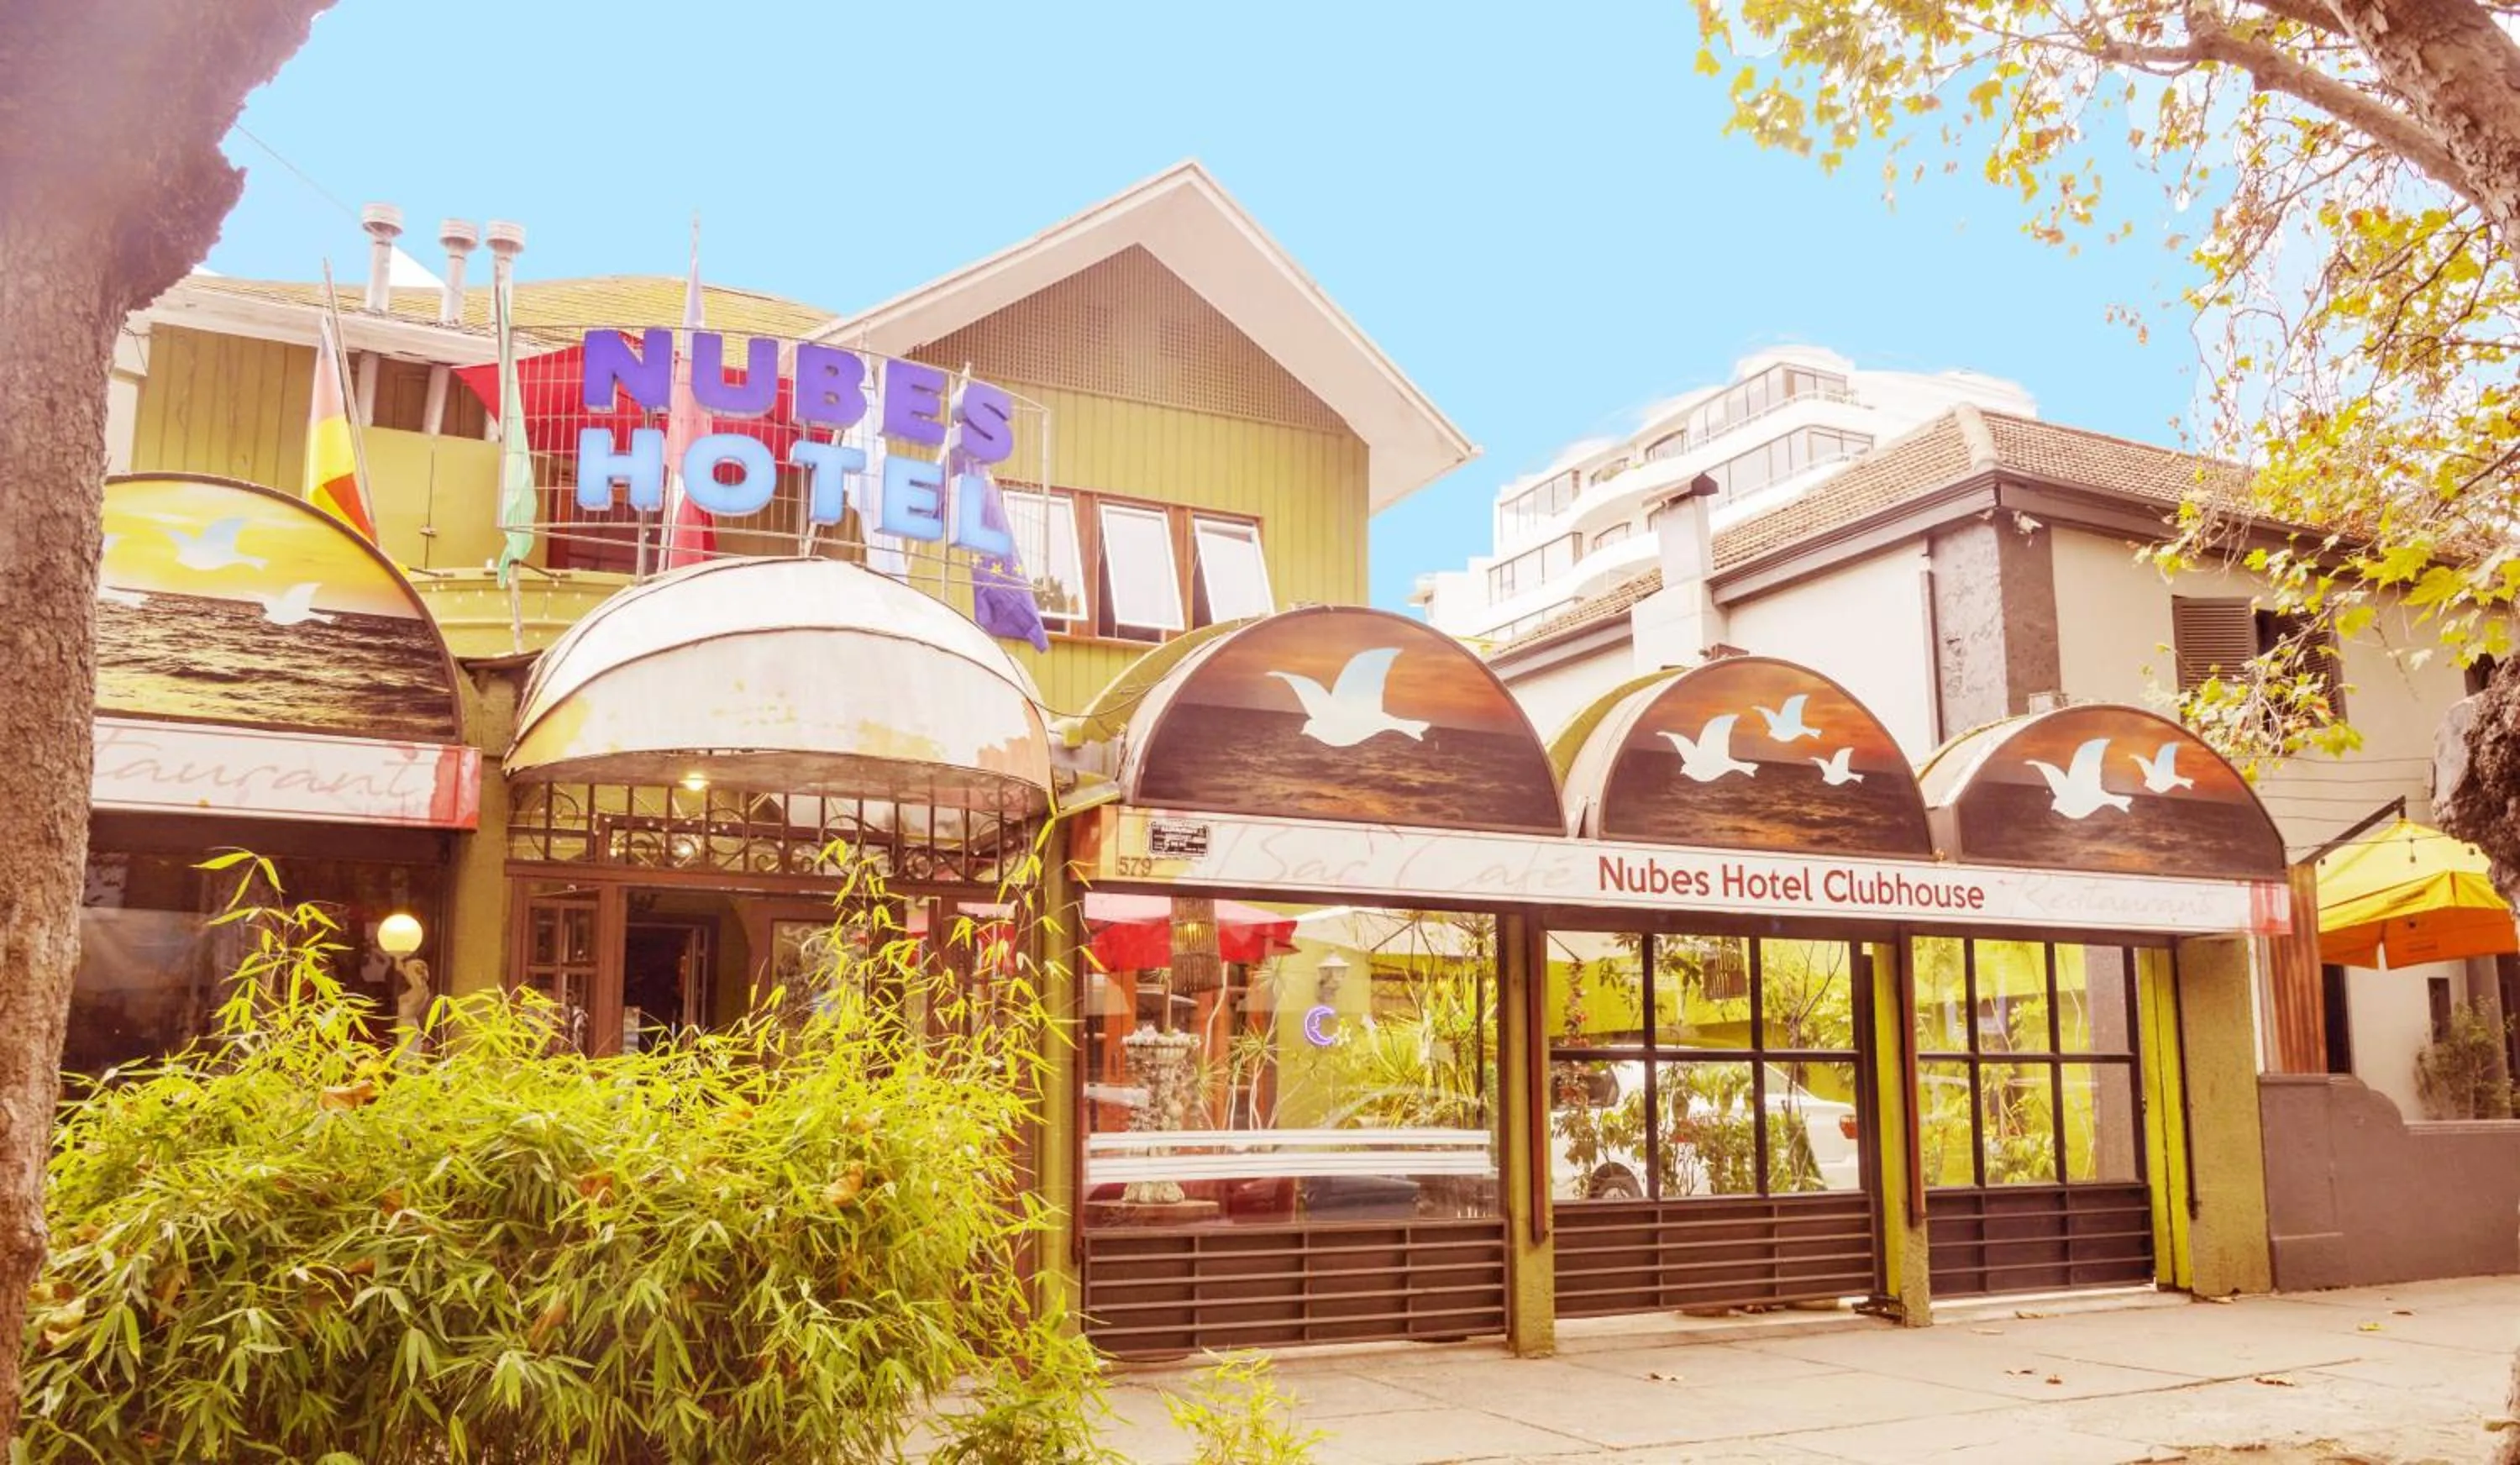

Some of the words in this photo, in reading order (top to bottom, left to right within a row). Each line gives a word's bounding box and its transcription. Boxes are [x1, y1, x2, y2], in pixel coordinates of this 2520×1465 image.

[583, 326, 1014, 464] NUBES
[576, 427, 1012, 556] HOTEL
[1117, 856, 1152, 877] 579
[1599, 855, 1710, 897] Nubes
[1722, 864, 1814, 902] Hotel
[1823, 869, 1986, 910] Clubhouse
